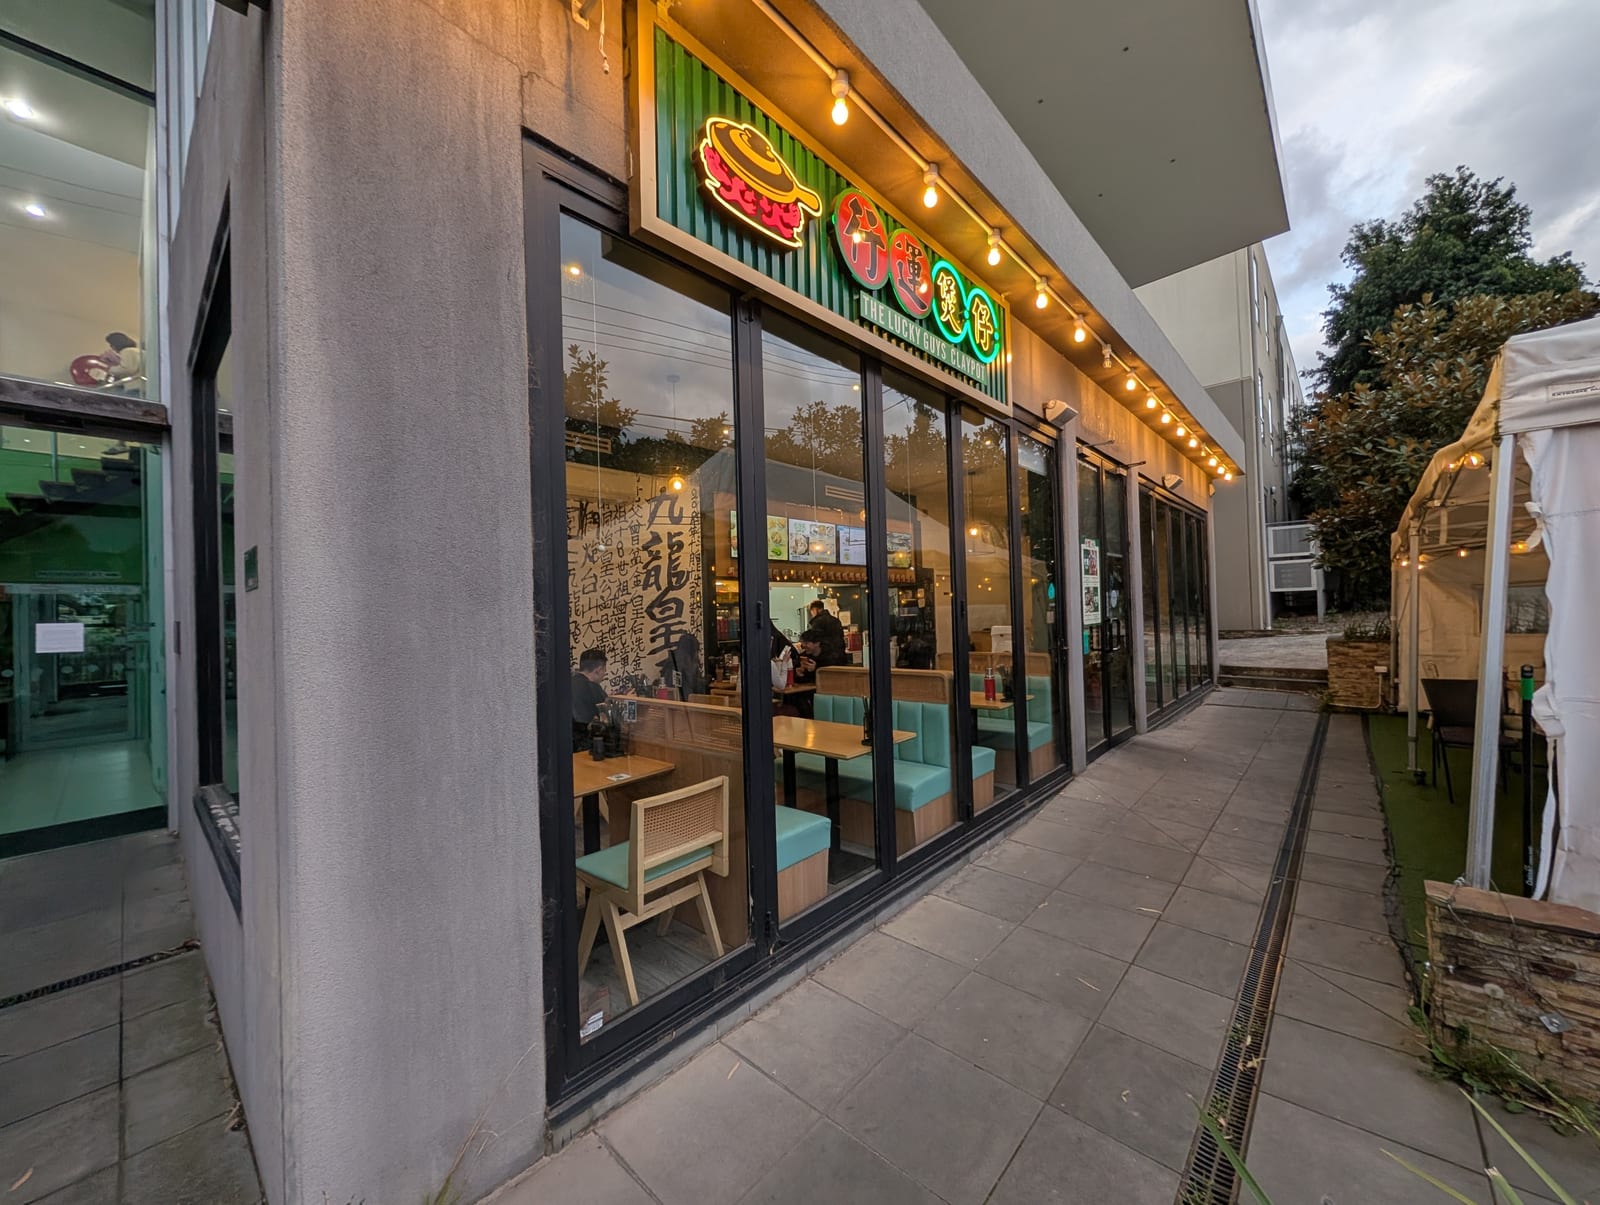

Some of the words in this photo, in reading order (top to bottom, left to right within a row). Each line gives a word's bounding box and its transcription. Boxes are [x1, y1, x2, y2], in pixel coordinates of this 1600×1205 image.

[844, 197, 993, 351] 行運煲仔
[863, 294, 885, 325] THE
[888, 310, 921, 345] LUCKY
[923, 331, 947, 361] GUYS
[950, 348, 986, 381] CLAYPOT
[641, 490, 690, 672] 九龍皇
